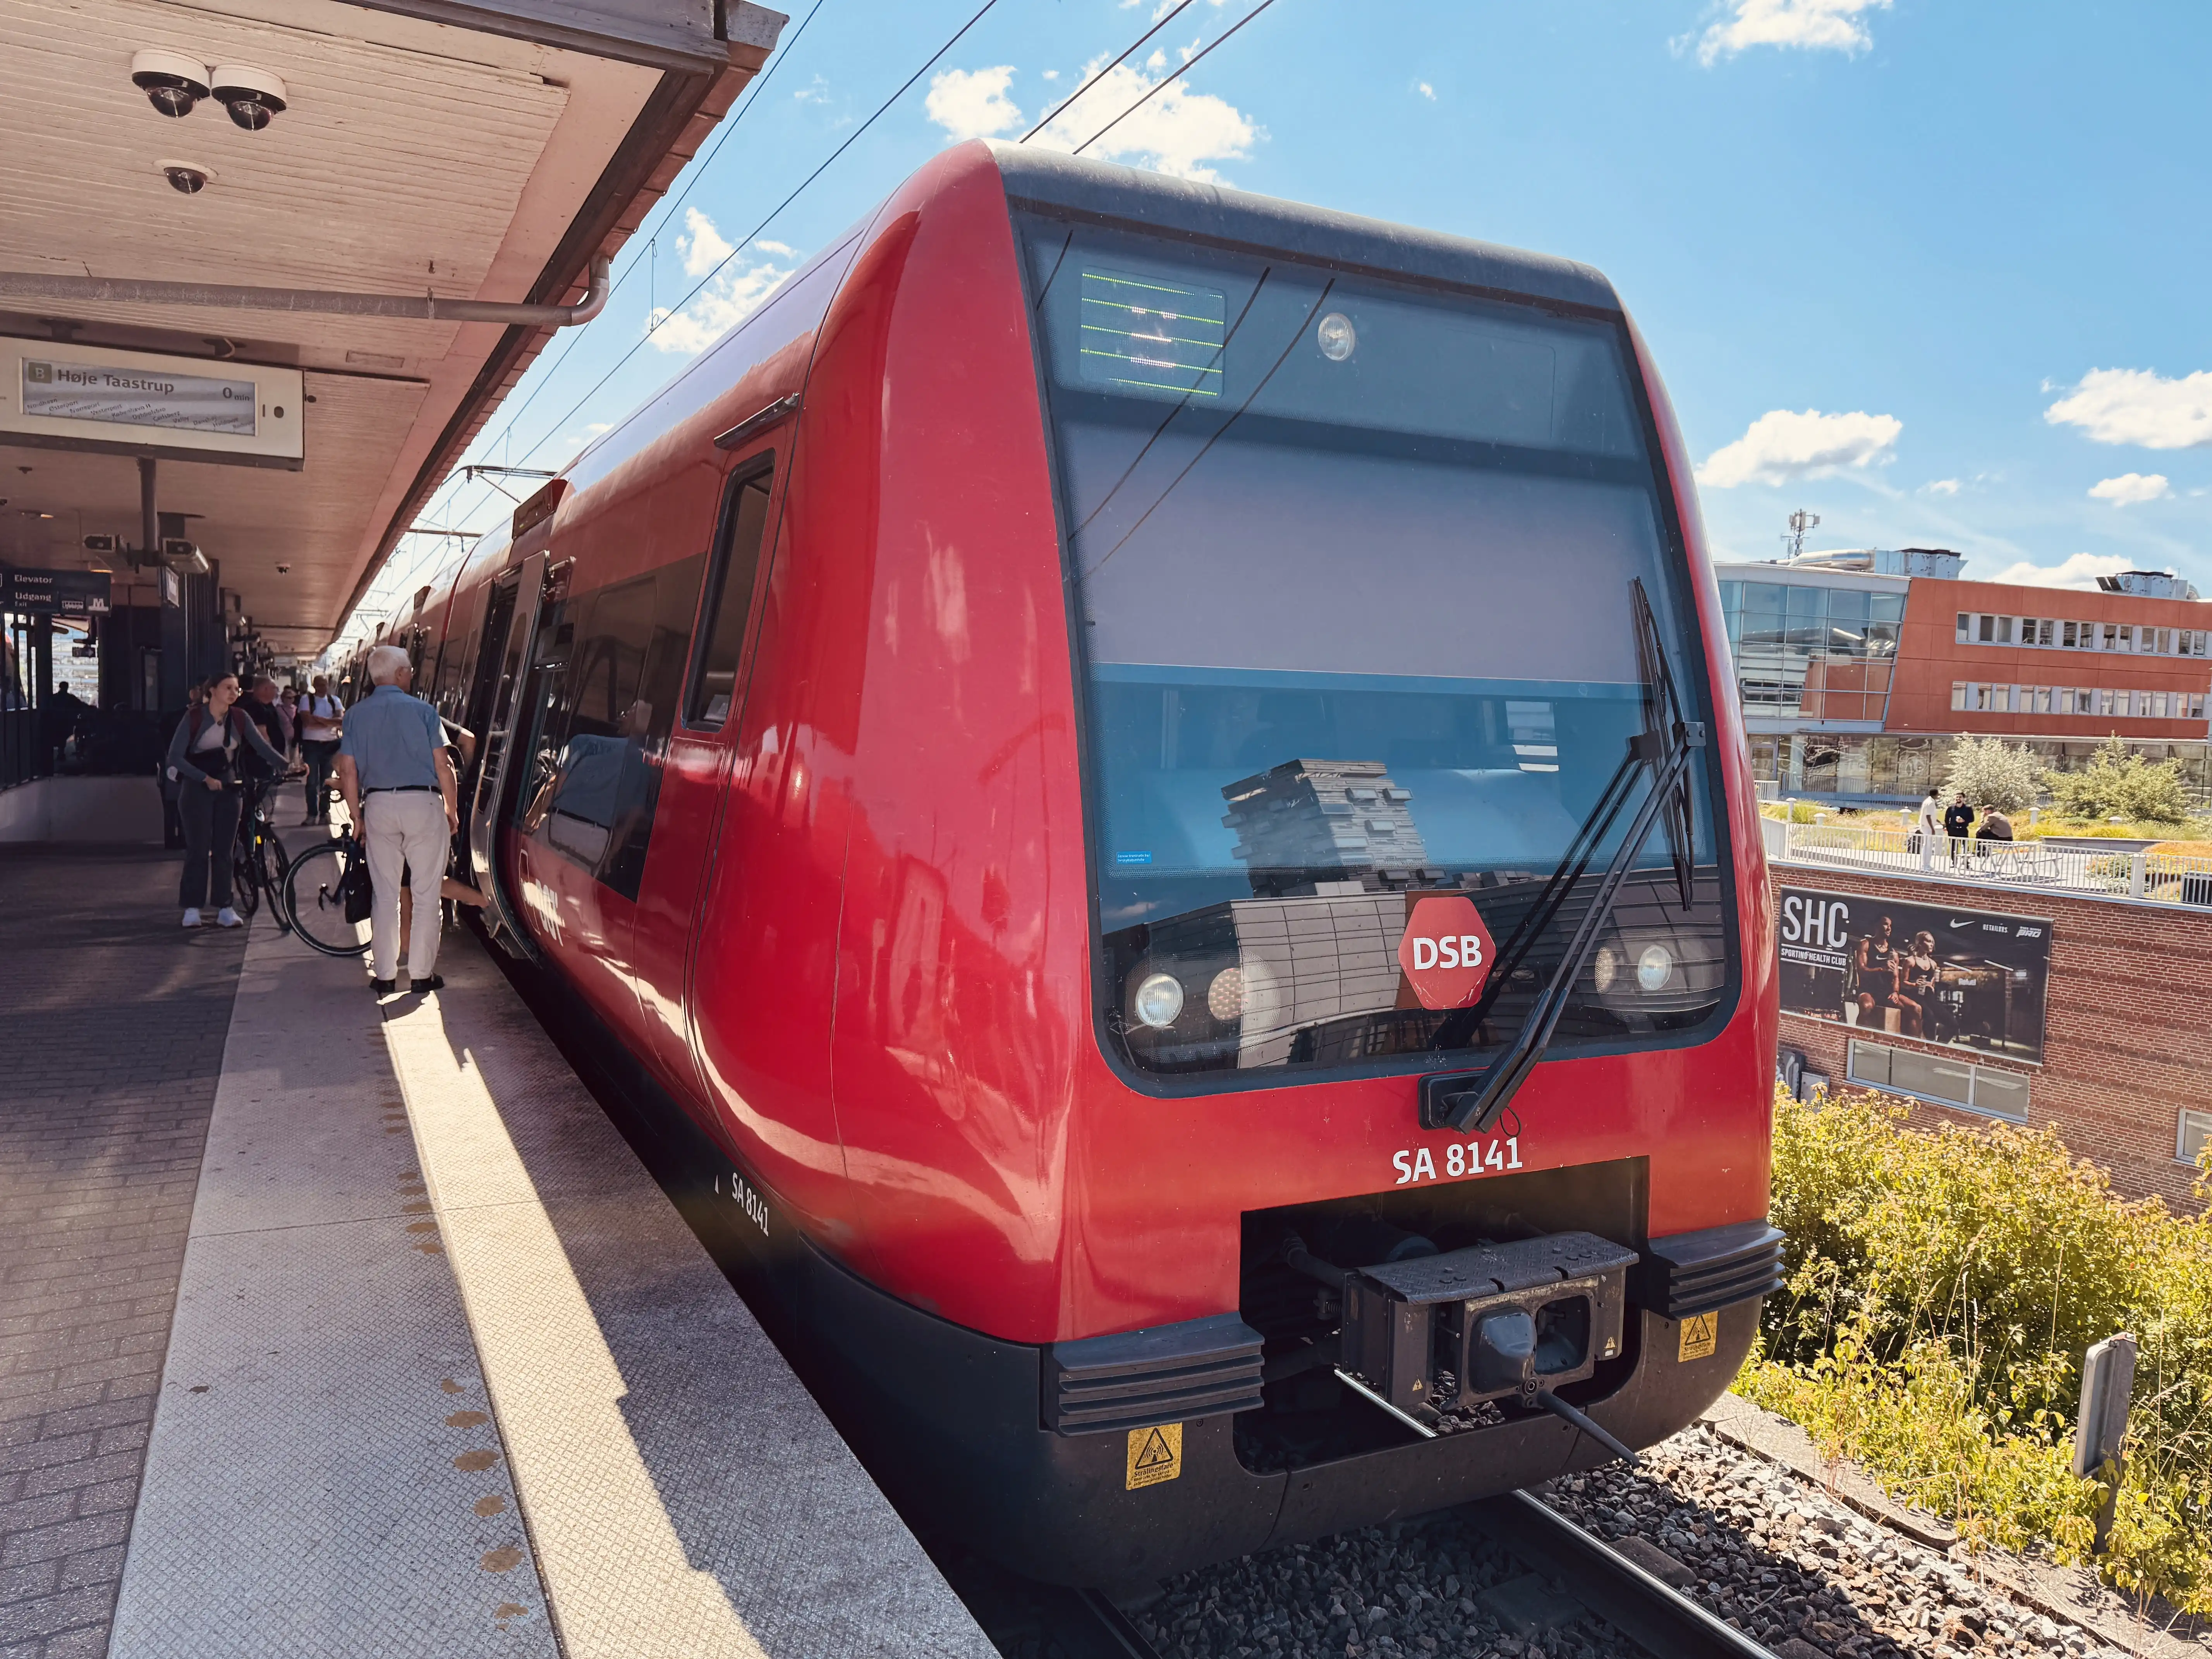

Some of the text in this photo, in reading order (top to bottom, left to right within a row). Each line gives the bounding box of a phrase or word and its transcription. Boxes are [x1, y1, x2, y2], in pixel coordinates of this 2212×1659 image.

[35, 368, 45, 379] B
[57, 369, 174, 395] Høje Taastrup
[223, 387, 232, 398] 0
[14, 574, 53, 584] Elevator
[15, 591, 52, 603] Udgang
[1783, 896, 1849, 948] SHC
[1413, 935, 1482, 970] DSB
[1809, 952, 1831, 963] HEALTH
[1831, 956, 1847, 966] CLUB
[1392, 1137, 1523, 1185] SA 8141
[732, 1172, 769, 1237] SA 8141
[1134, 1463, 1173, 1477] Strålingsfare
